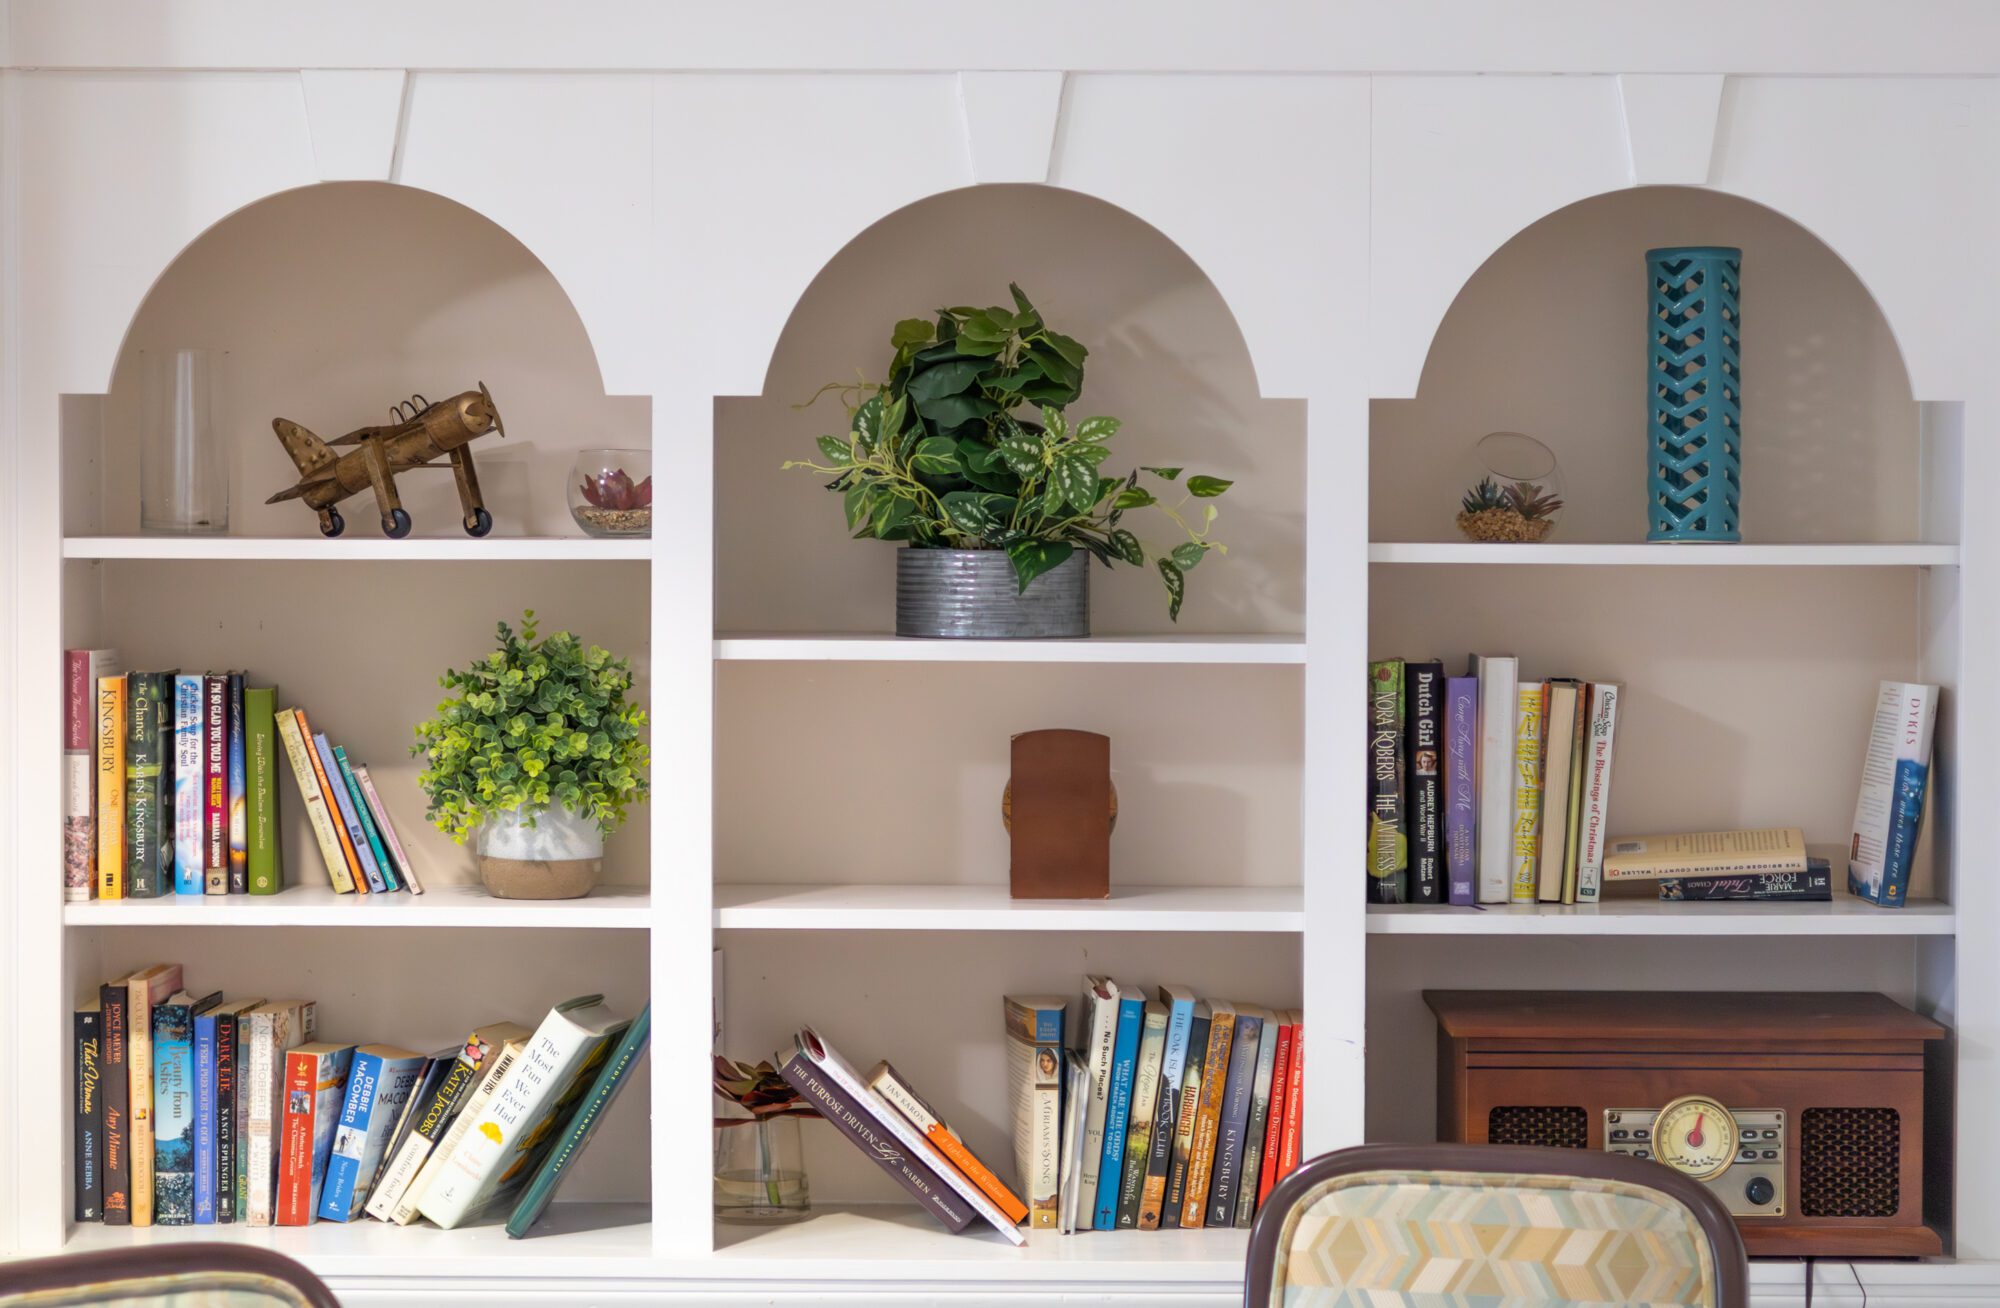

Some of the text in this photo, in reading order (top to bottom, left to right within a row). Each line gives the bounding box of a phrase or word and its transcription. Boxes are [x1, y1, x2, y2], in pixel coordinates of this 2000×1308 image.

[72, 659, 81, 746] The Stone Flower Garden
[136, 697, 146, 741] Chance
[179, 683, 188, 766] Christian Family Soul
[1418, 672, 1433, 746] Dutch Girl
[1600, 690, 1615, 736] Chicken Soup
[1904, 697, 1920, 745] DYKES
[102, 690, 116, 773] KINGSBURY
[188, 716, 197, 735] Soup
[210, 683, 221, 773] I'M SO GLAD YOU TOLD ME
[1370, 691, 1396, 780] NORA ROBERTS
[1450, 695, 1470, 810] Come Away with Me
[1585, 739, 1606, 863] The Blessings of Christmas
[1900, 767, 1911, 795] whose
[135, 754, 146, 862] KAREN KINGSBURY
[1896, 800, 1907, 828] waves
[1375, 793, 1398, 870] THE WITNESS
[1520, 817, 1532, 864] Robin Sloan
[1893, 832, 1903, 857] these
[1708, 878, 1752, 893] Fatal
[1759, 873, 1796, 883] FORCE
[1764, 882, 1792, 890] MARIE
[112, 1003, 120, 1029] JOYCE
[199, 1044, 208, 1067] FEEL
[219, 1024, 231, 1091] DARK LIE
[528, 1049, 554, 1073] Most
[541, 1037, 560, 1057] The
[610, 1054, 629, 1081] GUIDE
[1096, 1031, 1110, 1100] No Such Places?
[83, 1038, 98, 1113] That Woman
[160, 1061, 171, 1095] Ashes
[169, 1046, 187, 1118] Beauty from
[199, 1068, 208, 1110] PRECIOUS
[257, 1025, 268, 1116] NORA ROBERTS
[344, 1060, 367, 1123] MACOMBER
[394, 1075, 416, 1088] DEBB
[481, 1052, 514, 1096] HOWARD FAST
[514, 1079, 531, 1097] We
[521, 1064, 542, 1085] Fun
[600, 1084, 610, 1096] TO
[1136, 1063, 1157, 1093] Hope
[1155, 1012, 1184, 1158] THE OAK ISLAND BOOK CLUB
[1231, 1043, 1249, 1118] WAITING FOR MORNING
[358, 1076, 373, 1112] DEBBIE
[417, 1061, 470, 1137] KATE JACOBS
[493, 1103, 517, 1125] Had
[501, 1089, 526, 1111] Ever
[885, 1083, 926, 1123] JAN KARON
[1111, 1059, 1130, 1161] WHAT ARE THE ODDS?
[1140, 1095, 1149, 1107] JAR
[1178, 1085, 1196, 1136] HARBINGER
[1254, 1095, 1263, 1121] LOWLY
[1267, 1039, 1288, 1159] WEBSTER'S NEW BASIC DICTIONARY
[106, 1105, 120, 1169] Any Minute
[199, 1126, 208, 1145] GOD
[200, 1113, 208, 1124] TO
[572, 1098, 601, 1140] BILTMORE
[791, 1064, 905, 1174] THE PURPOSE DRIVEN Life
[1041, 1092, 1052, 1183] MIRIAM'S SONG
[333, 1160, 348, 1198] Navy Brides
[383, 1142, 420, 1198] comfort food
[552, 1143, 573, 1173] ESTATE
[900, 1165, 930, 1195] WARREN
[1218, 1129, 1236, 1200] KINGSBURY
[238, 1174, 246, 1200] GRANT
[1123, 1159, 1136, 1205] BRUNSTETTER
